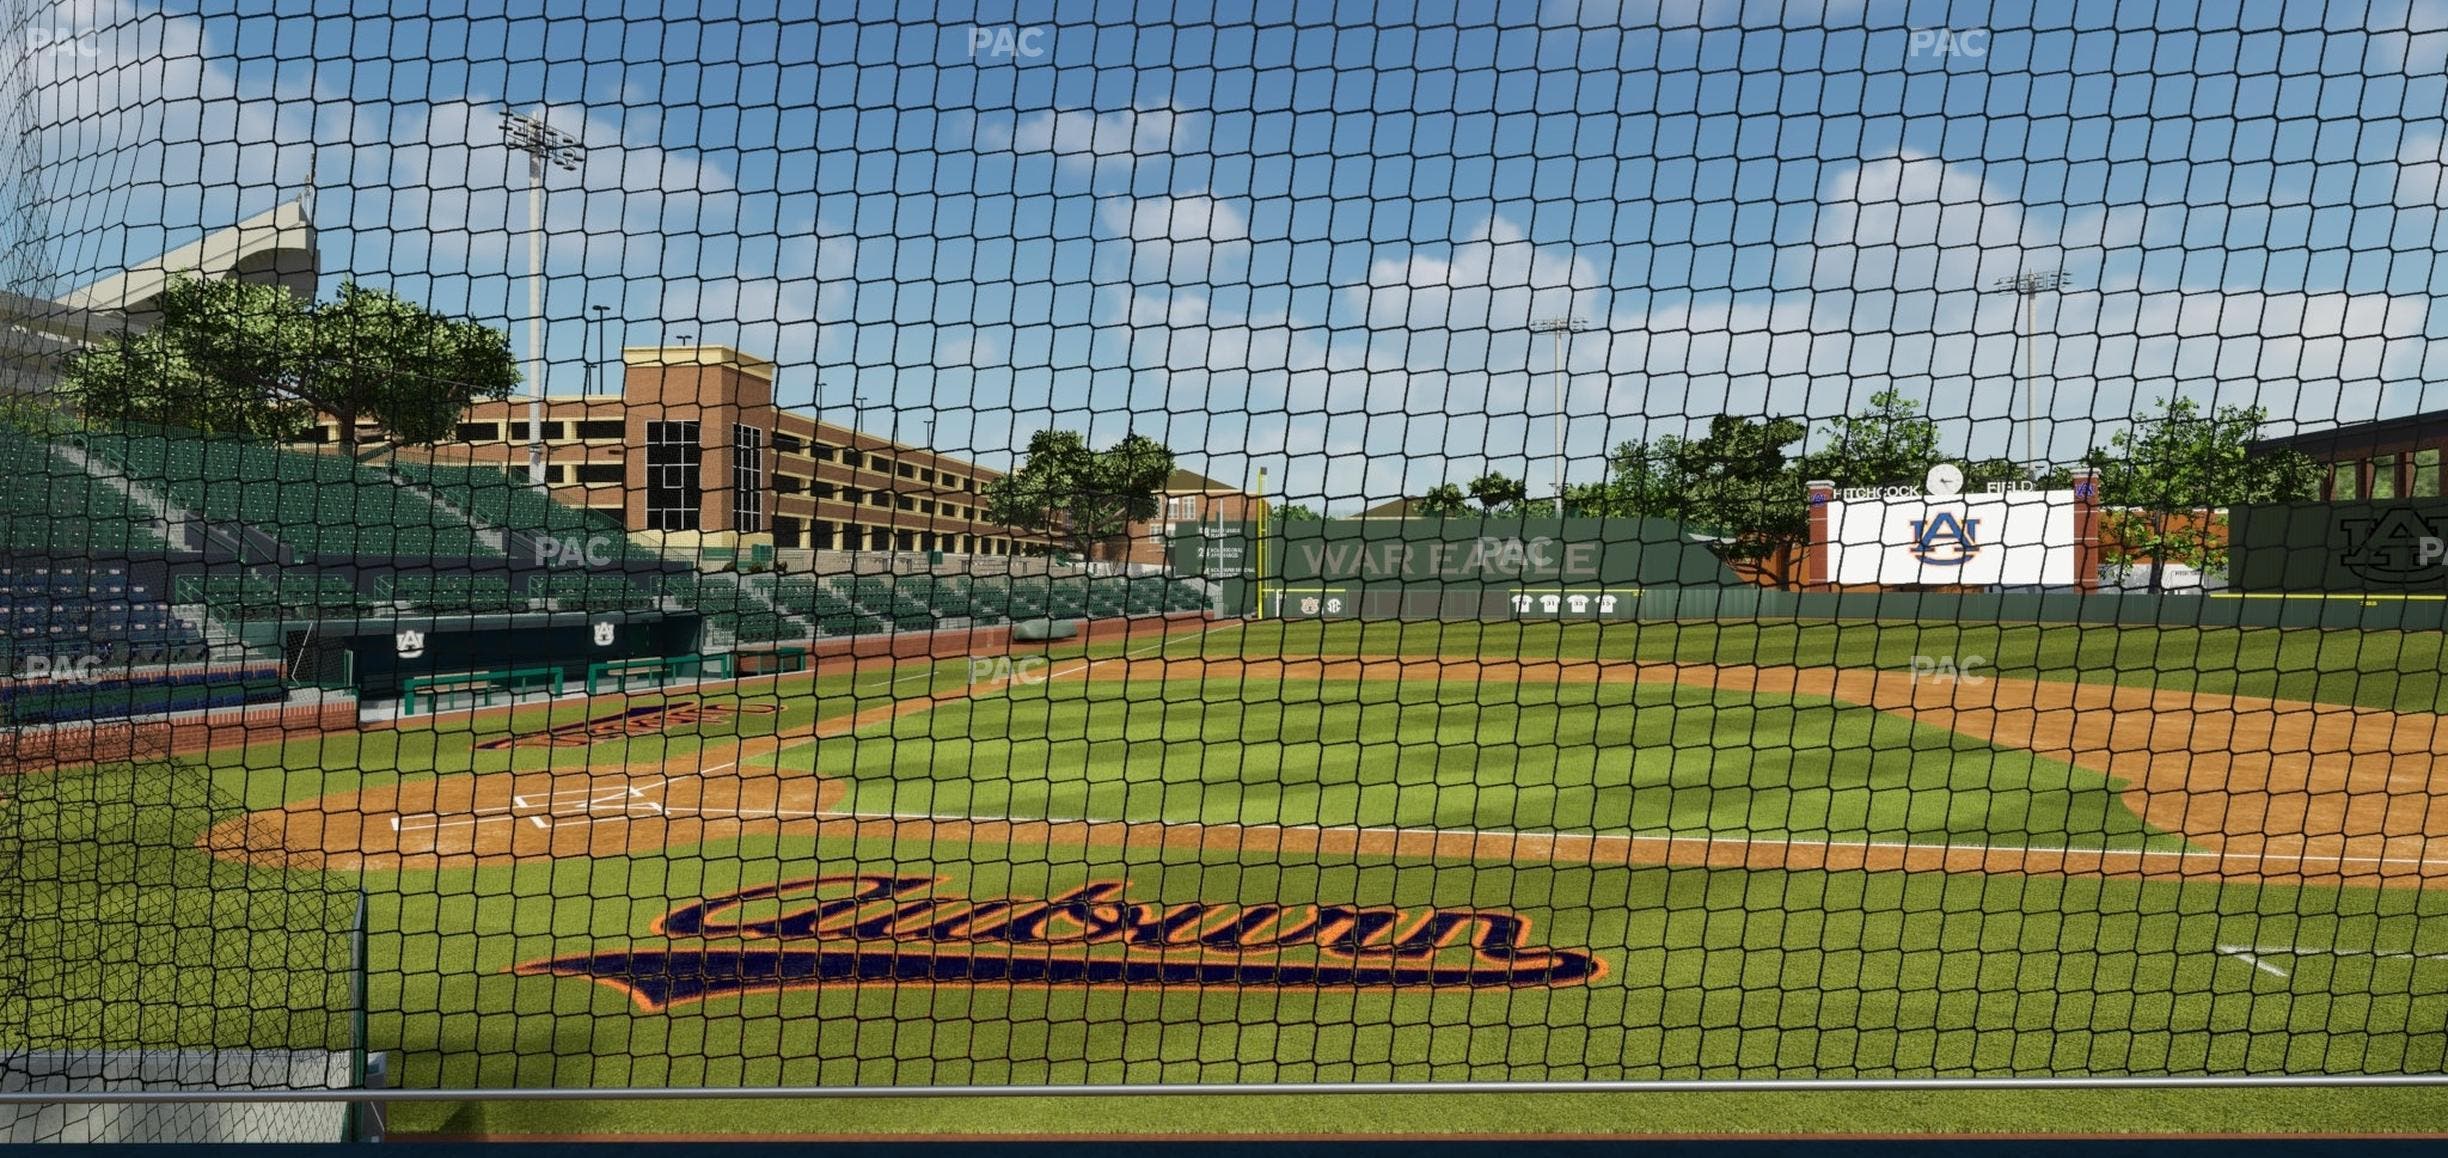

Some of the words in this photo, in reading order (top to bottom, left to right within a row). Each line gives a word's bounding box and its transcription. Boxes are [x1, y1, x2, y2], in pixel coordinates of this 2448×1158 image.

[1833, 486, 1921, 499] HITCHCOCK
[1987, 480, 2033, 493] FIELD
[1302, 544, 1415, 575] WAR
[1430, 542, 1598, 575] EAGLE
[650, 874, 1540, 966] Auburn
